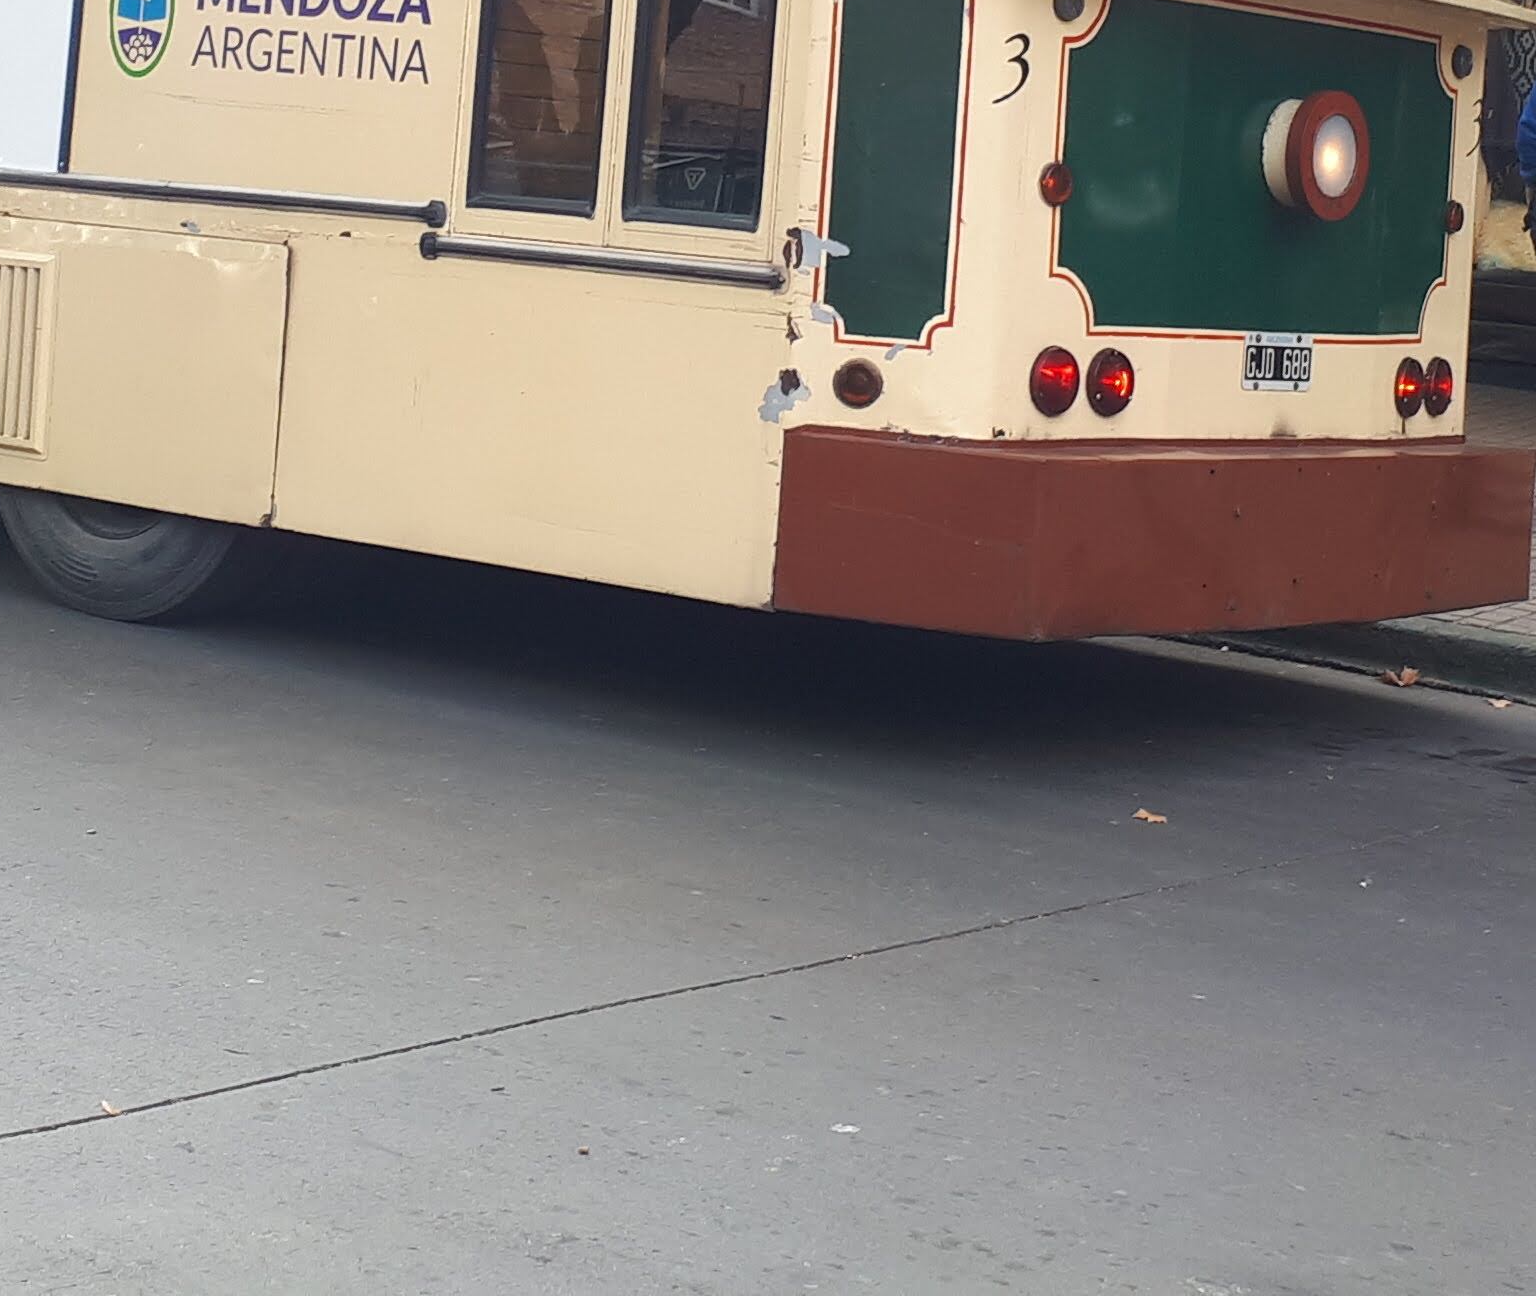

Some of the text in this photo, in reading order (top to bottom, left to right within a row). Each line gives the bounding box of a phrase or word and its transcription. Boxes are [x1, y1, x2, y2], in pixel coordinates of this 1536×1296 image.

[191, 25, 430, 85] ARGENTINA
[992, 33, 1030, 104] 3
[1246, 347, 1310, 380] GJD 688
